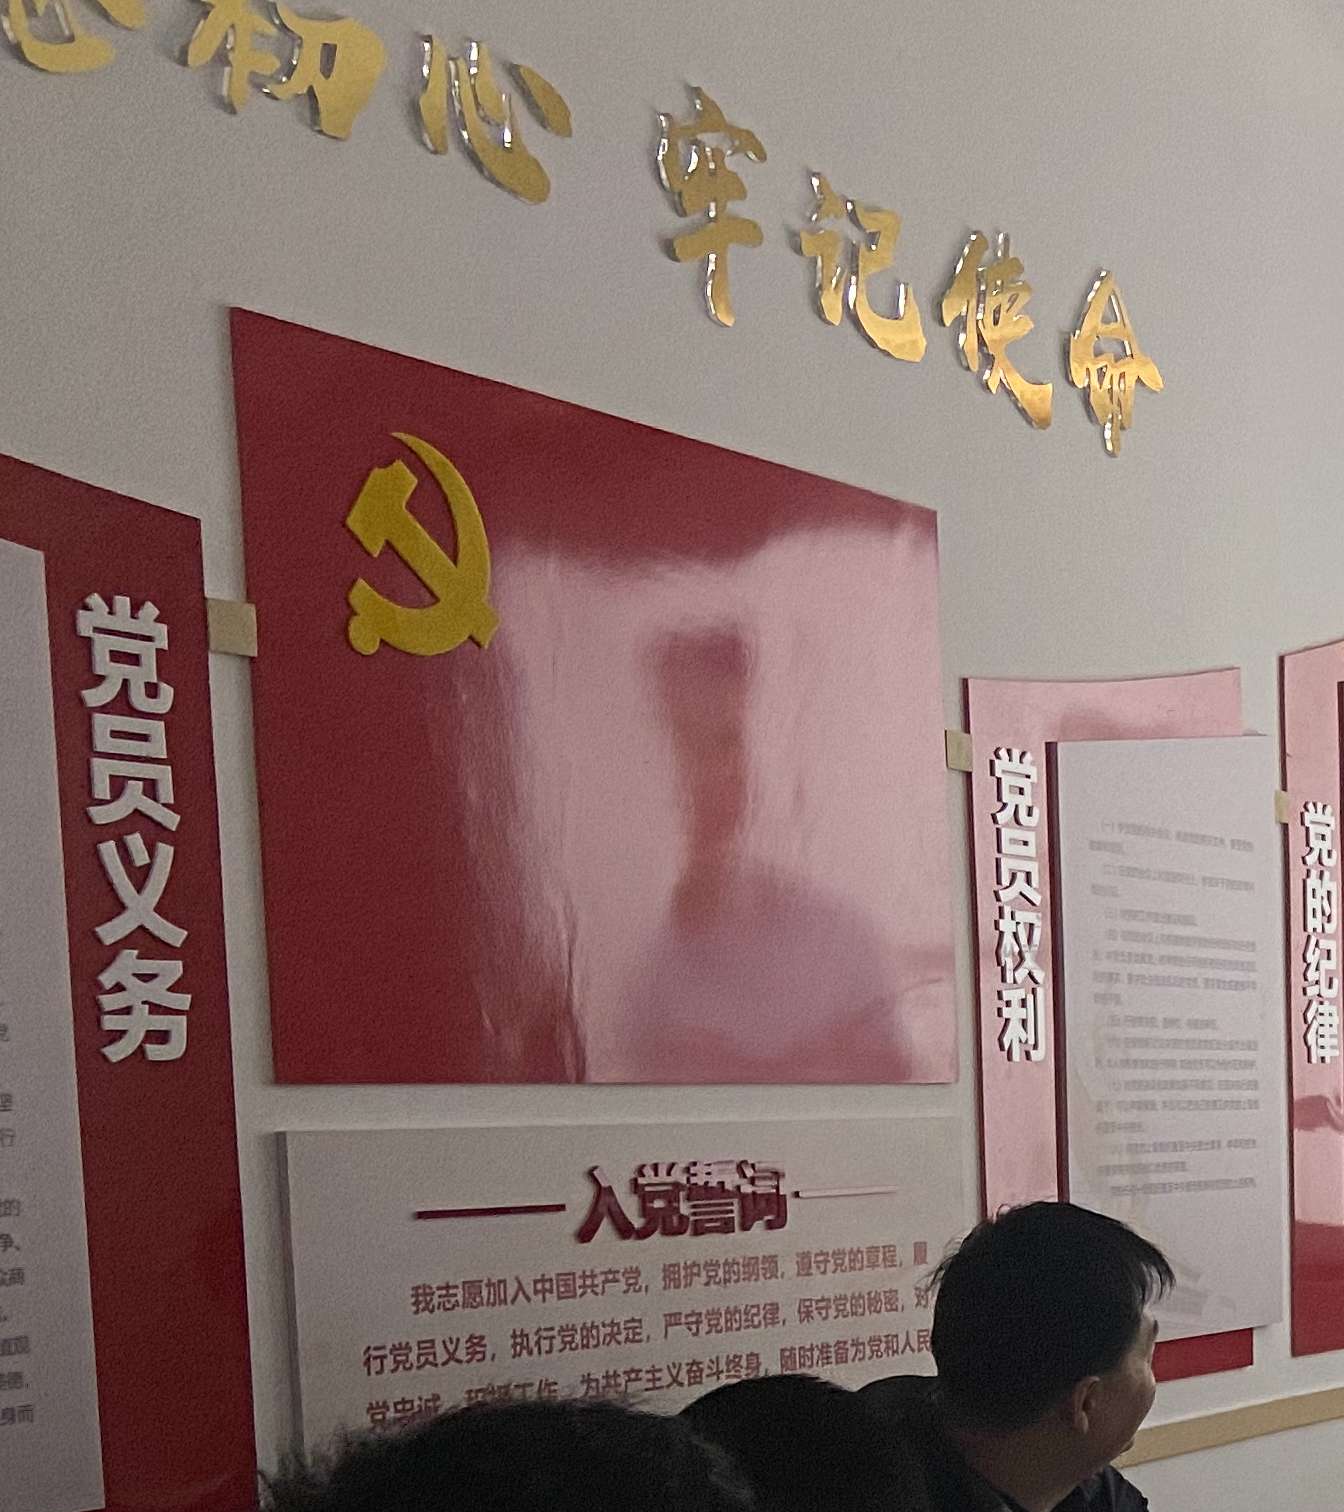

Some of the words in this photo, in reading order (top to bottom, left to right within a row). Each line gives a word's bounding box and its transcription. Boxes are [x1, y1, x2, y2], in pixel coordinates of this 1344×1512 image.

[655, 85, 1164, 458] 牢记使命
[76, 593, 193, 1063] 党员义务
[989, 746, 1046, 1063] 党员权利
[1300, 801, 1340, 1065] 党的纪律
[577, 1158, 788, 1244] 入党誓词
